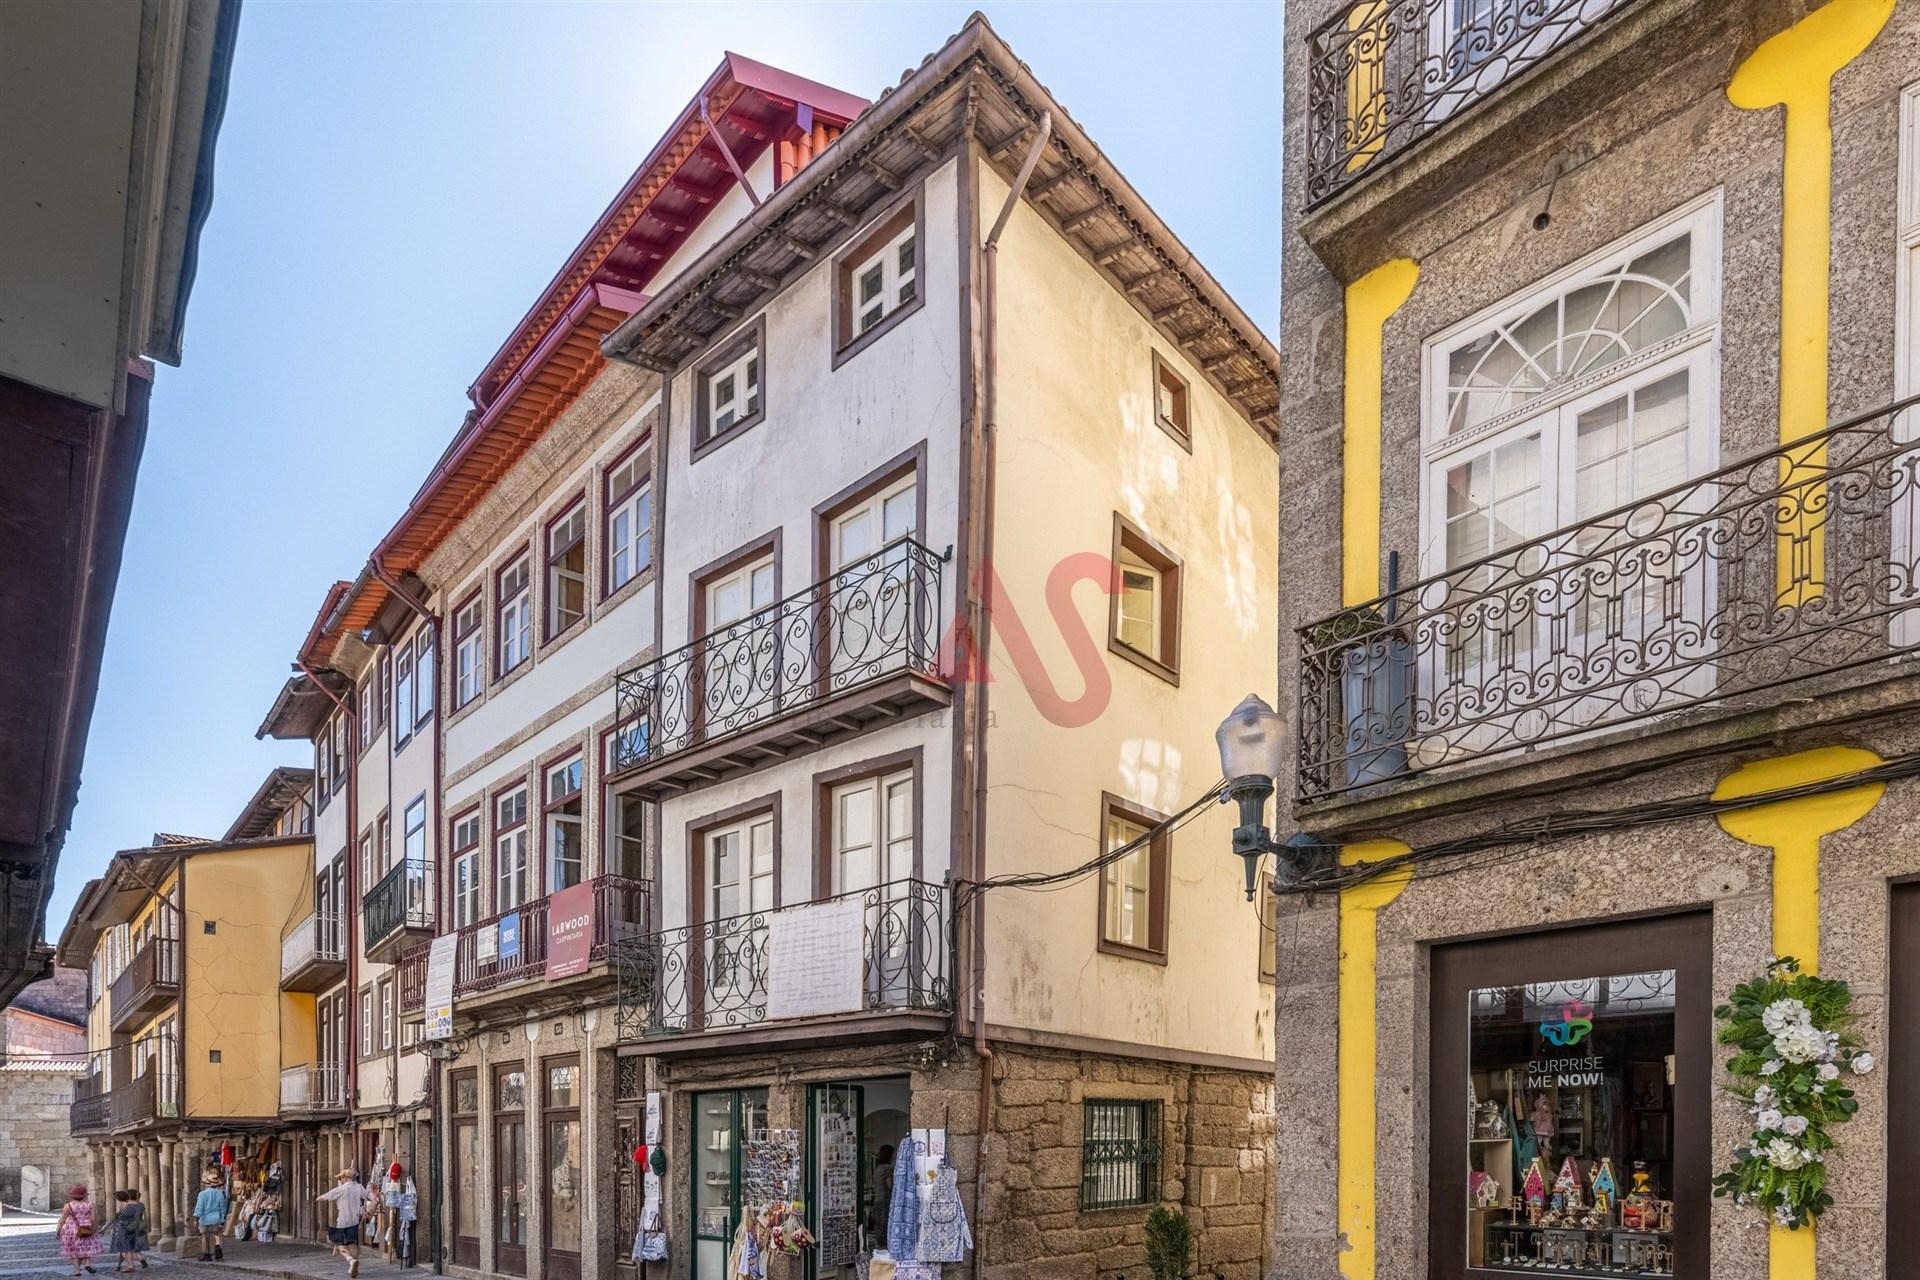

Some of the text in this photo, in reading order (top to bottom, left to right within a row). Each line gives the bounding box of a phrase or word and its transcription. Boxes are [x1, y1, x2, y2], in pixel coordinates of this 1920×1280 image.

[552, 914, 589, 936] LABWOOD
[1528, 1056, 1604, 1074] SURPRISE
[1528, 1072, 1604, 1089] ME NOW!
